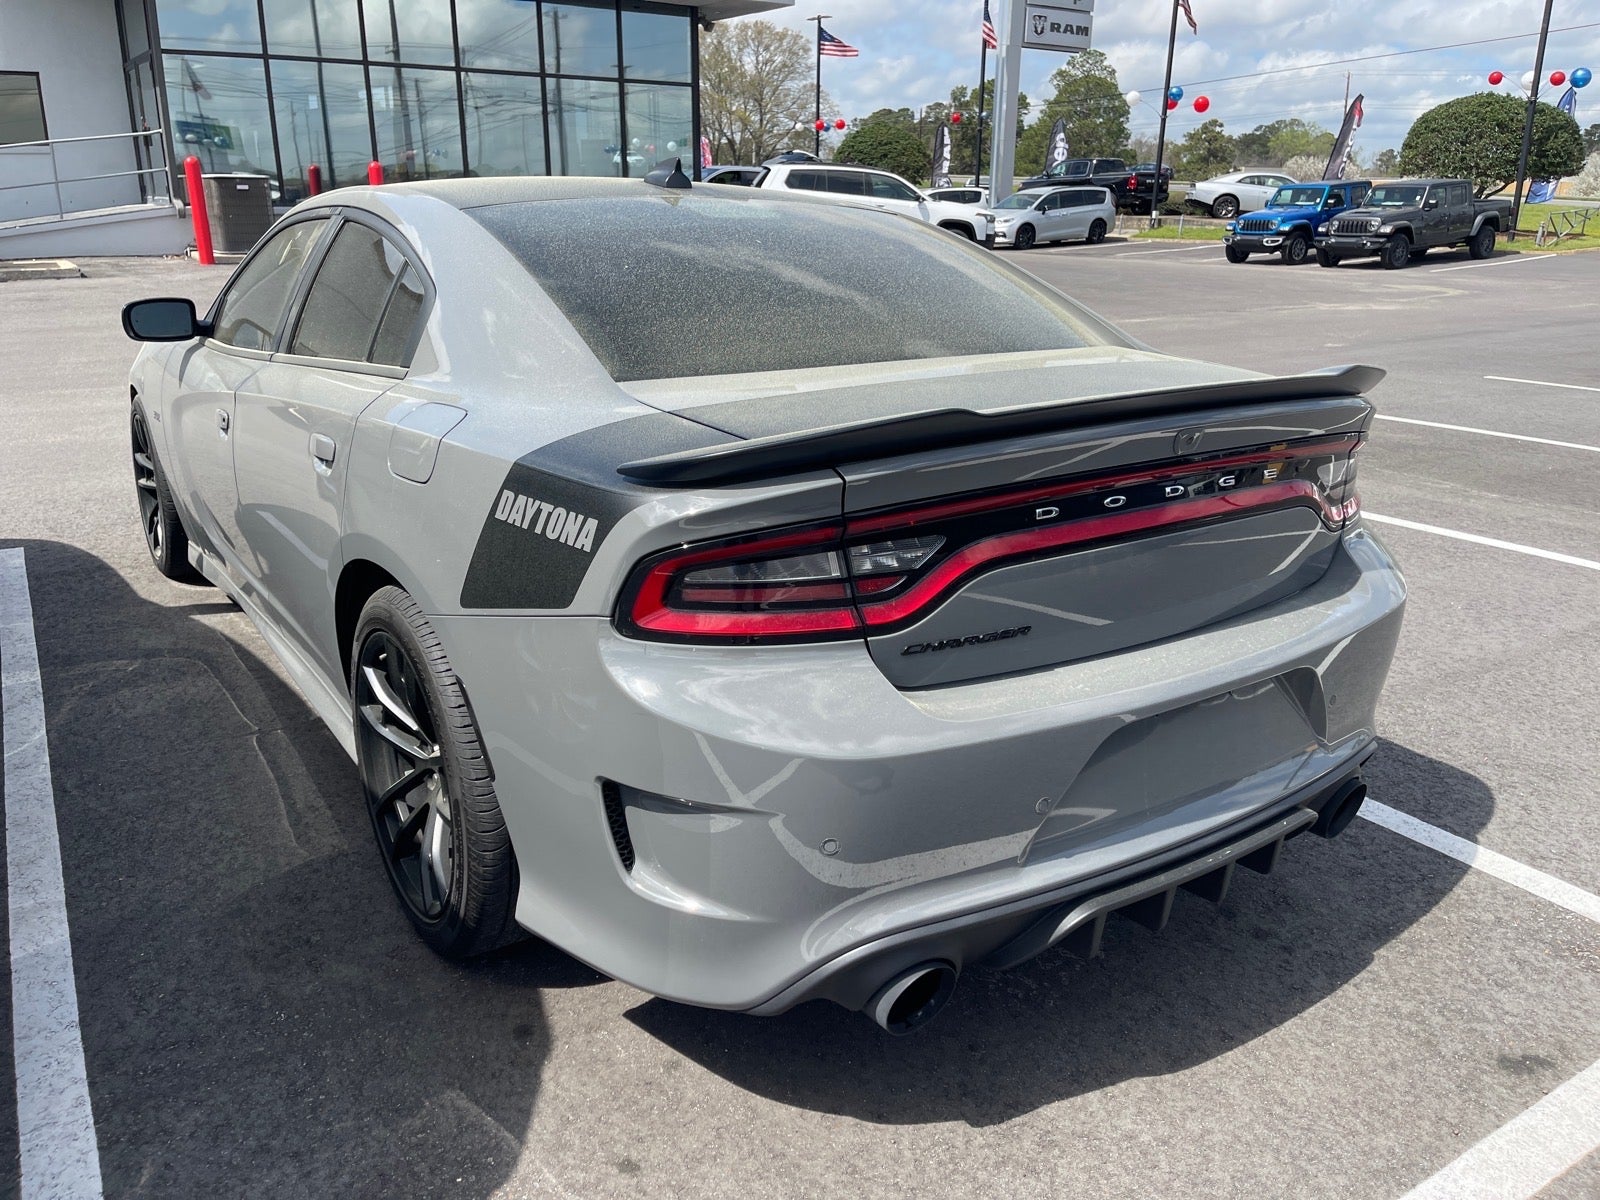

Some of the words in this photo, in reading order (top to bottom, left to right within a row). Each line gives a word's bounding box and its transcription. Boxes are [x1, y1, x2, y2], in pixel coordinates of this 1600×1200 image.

[1049, 22, 1089, 37] RAM
[1035, 467, 1278, 520] DODGE
[494, 489, 599, 553] DAYTONA
[900, 625, 1032, 656] CHARGER
